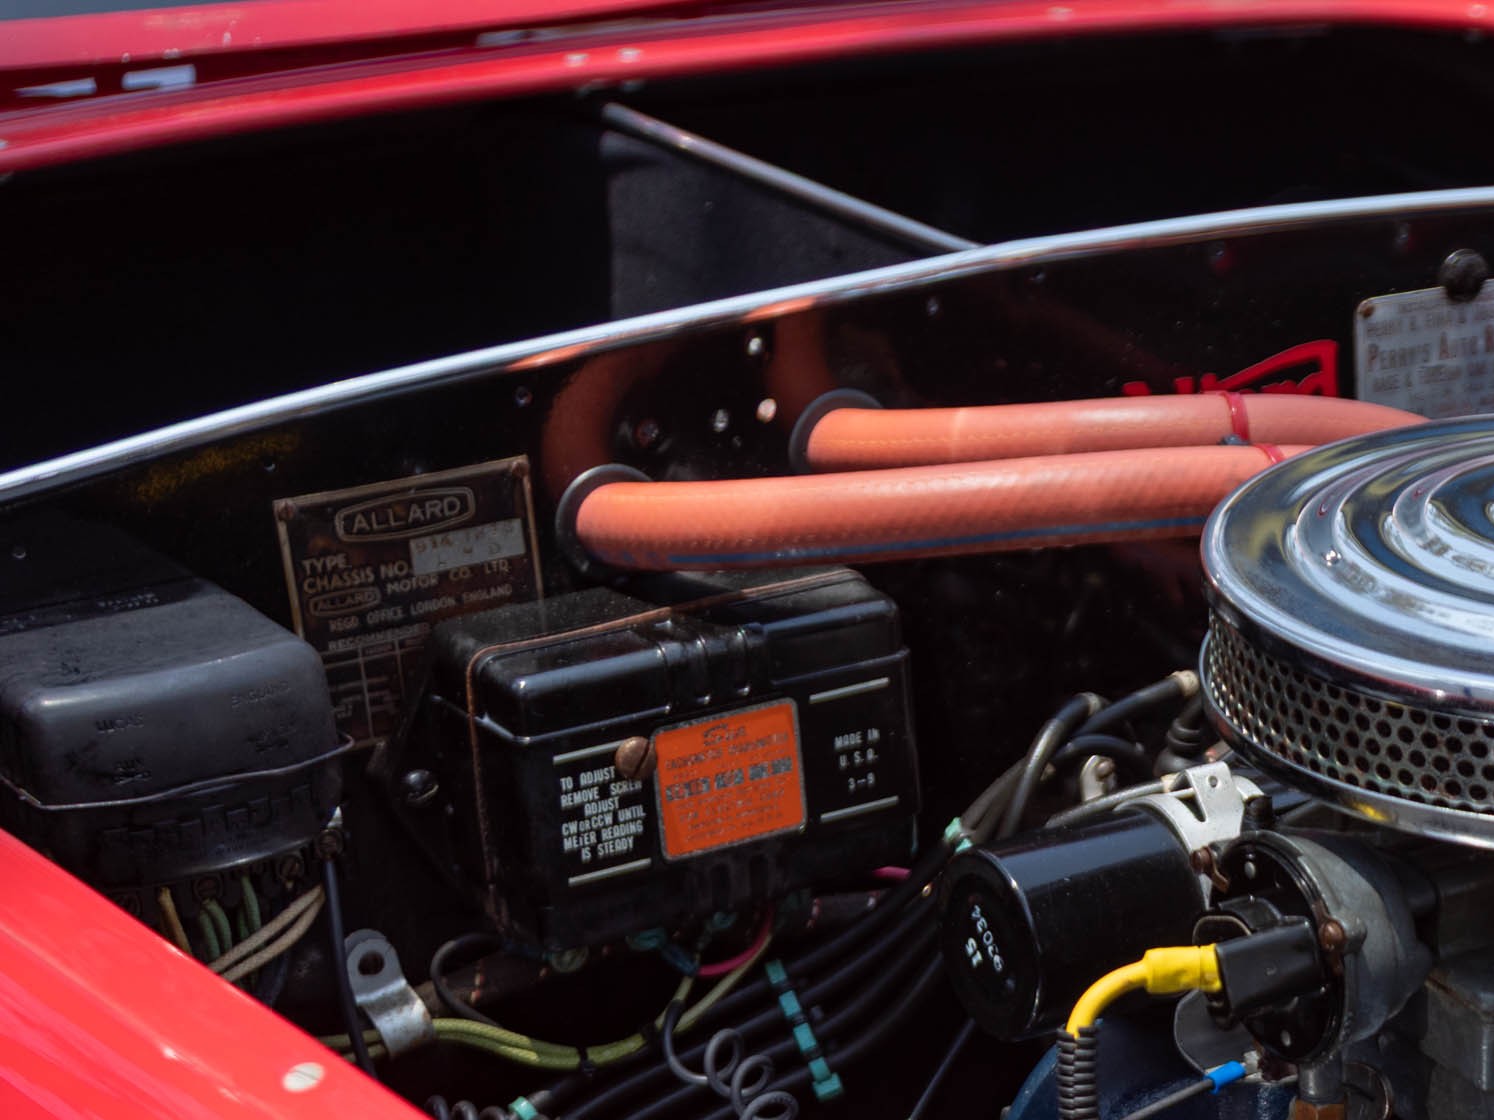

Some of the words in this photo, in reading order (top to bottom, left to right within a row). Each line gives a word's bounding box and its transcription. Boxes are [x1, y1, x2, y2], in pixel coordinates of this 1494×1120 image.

[351, 495, 461, 534] ALLARD
[303, 566, 375, 594] CHASSIS
[316, 591, 375, 612] ALLARD
[386, 574, 439, 595] MOTOR
[367, 606, 403, 625] OFFICE
[410, 597, 456, 616] LONDON
[462, 583, 513, 602] ENGLAND
[834, 730, 863, 751] MADE
[560, 776, 573, 792] TO
[579, 765, 616, 788] ADJUST
[560, 786, 600, 809] REMOVE
[584, 796, 620, 817] ADJUST
[617, 804, 647, 822] UNTIL
[563, 831, 597, 851] METER
[600, 820, 644, 842] READING
[581, 847, 592, 862] IS
[596, 836, 634, 857] STEADY
